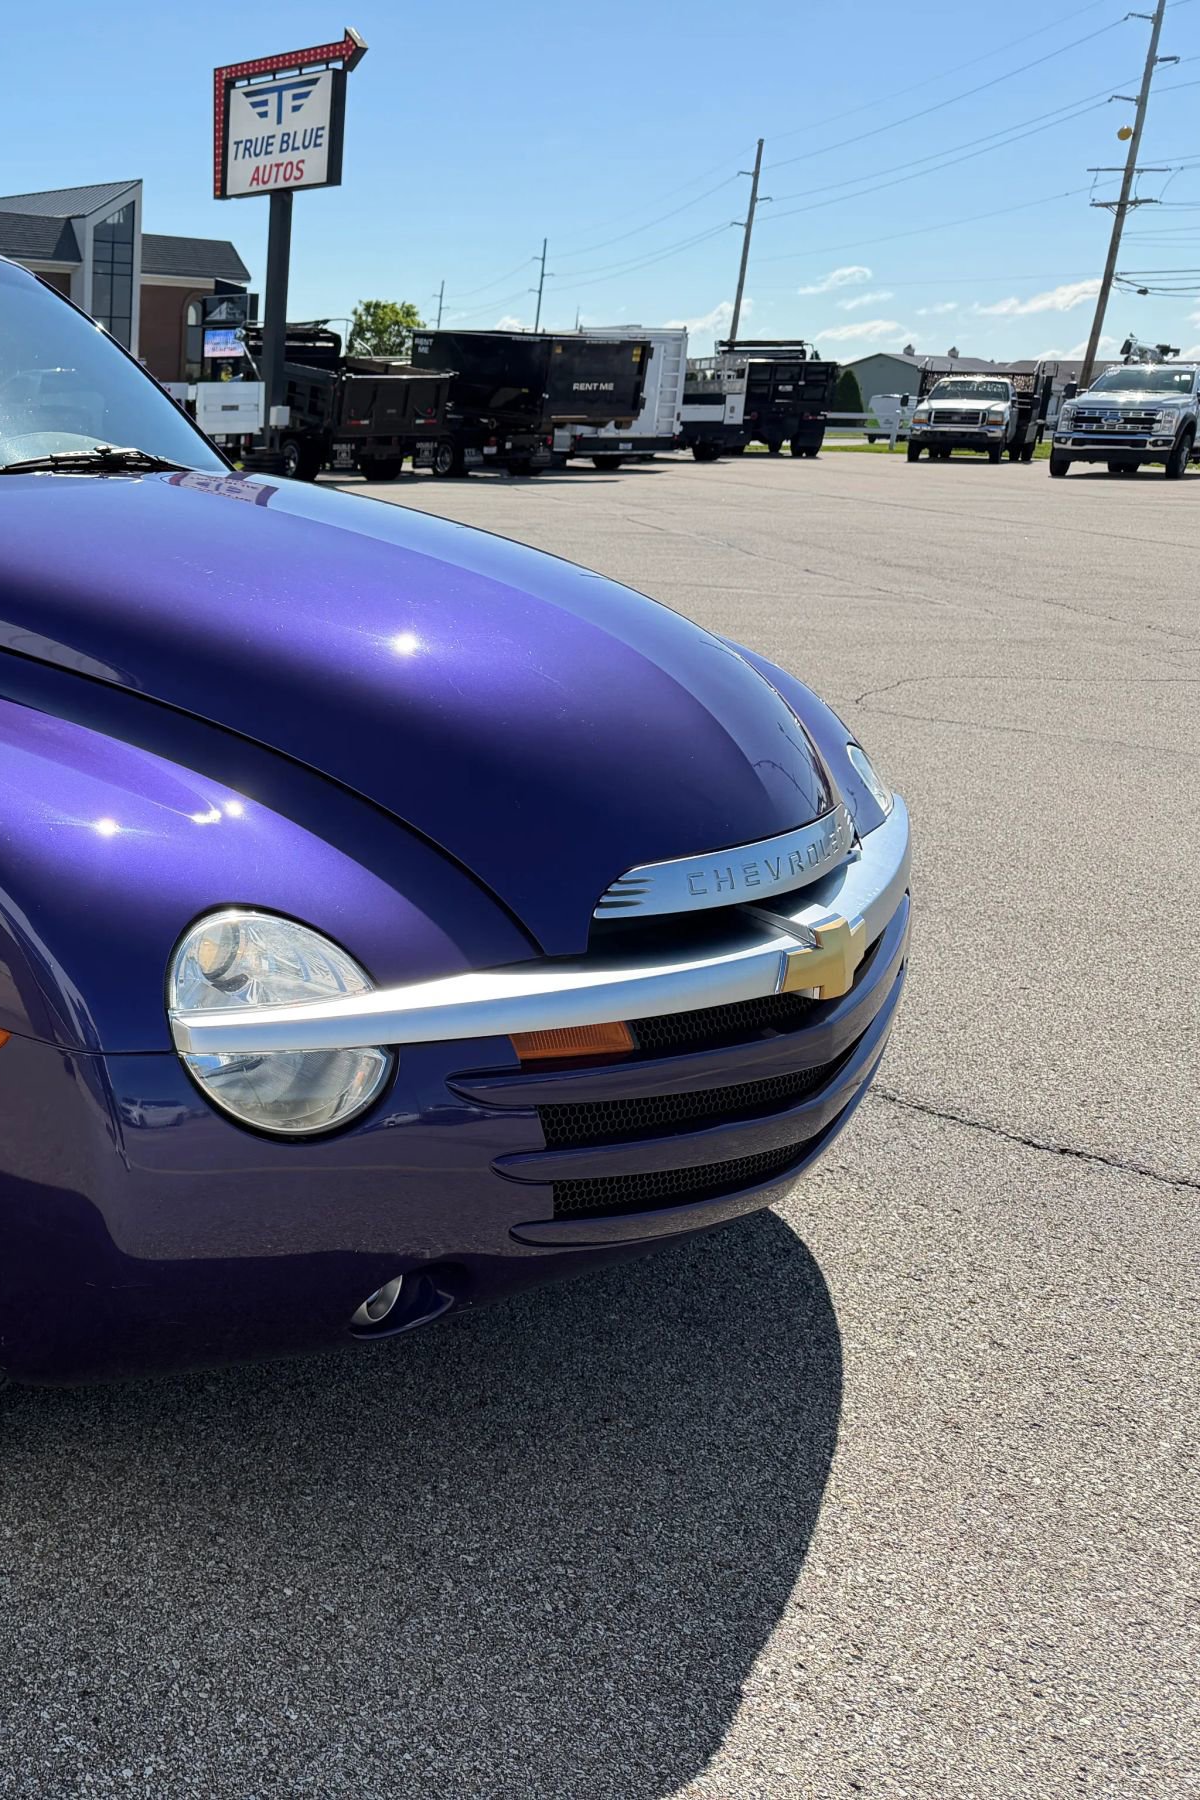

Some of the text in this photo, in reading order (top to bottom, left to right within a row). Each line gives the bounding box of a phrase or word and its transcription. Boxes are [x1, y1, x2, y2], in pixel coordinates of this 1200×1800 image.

[233, 126, 325, 160] TRUE BLUE
[249, 160, 305, 187] AUTOS
[415, 337, 433, 346] RENT
[418, 346, 430, 354] ME
[573, 382, 614, 391] RENT ME
[686, 822, 846, 896] CHEVROLET
